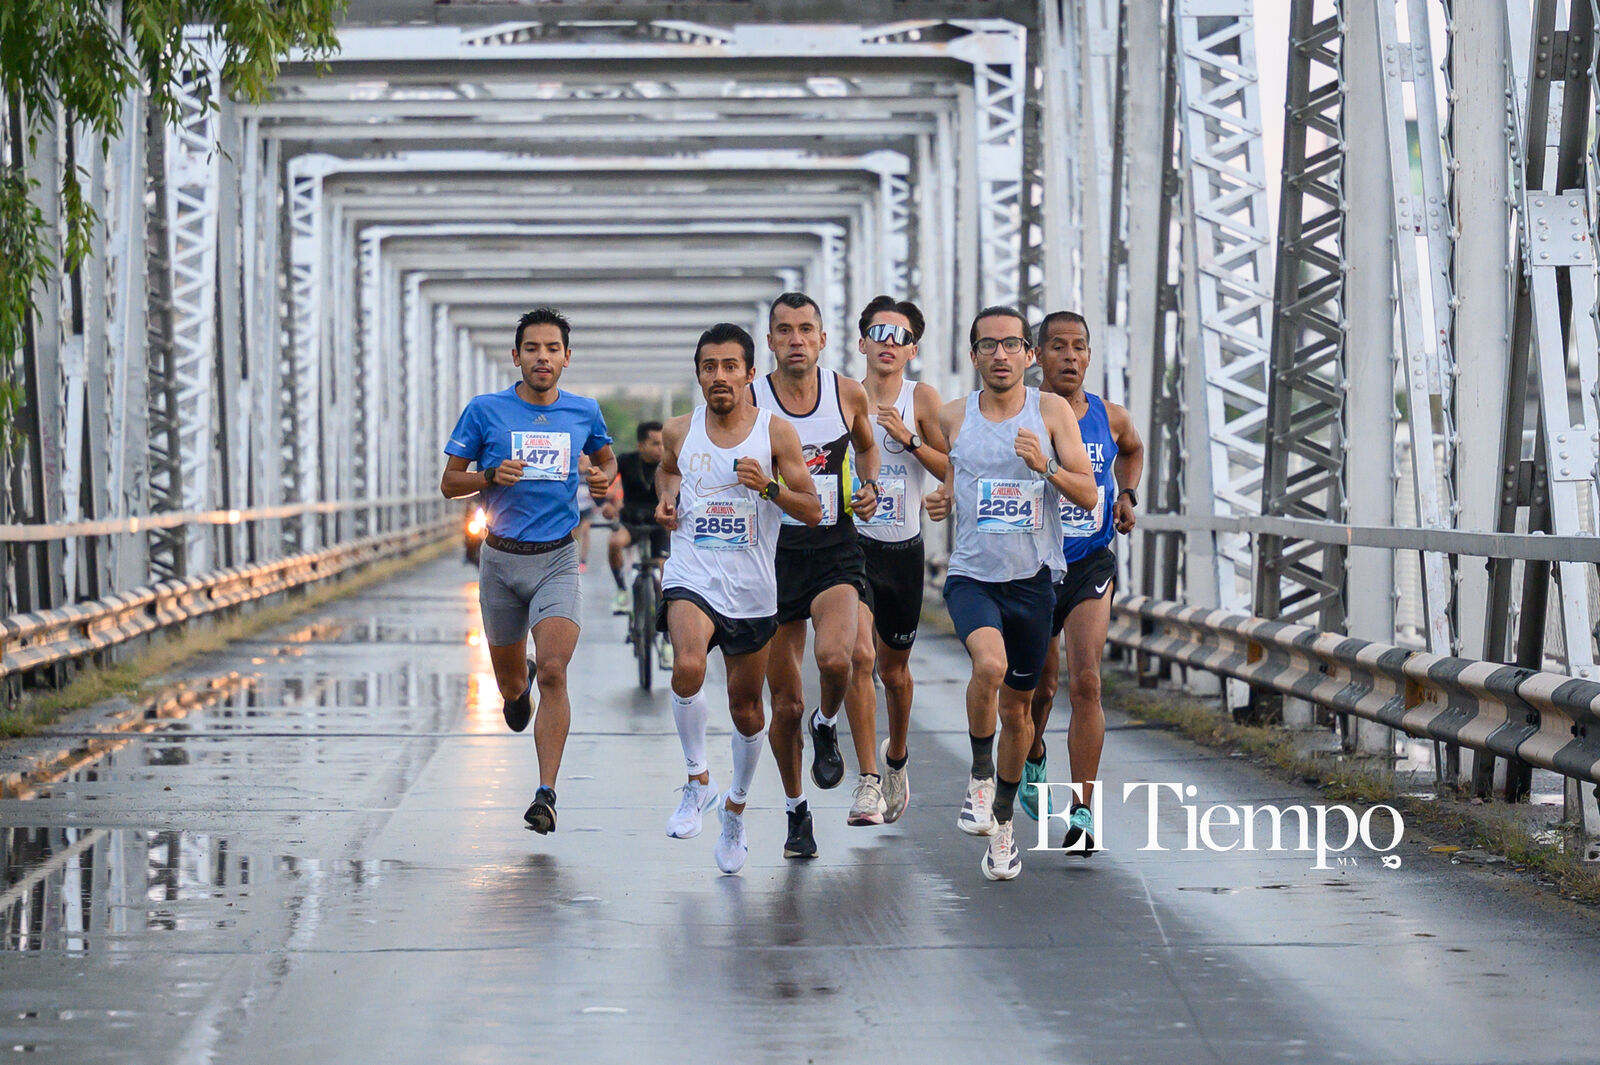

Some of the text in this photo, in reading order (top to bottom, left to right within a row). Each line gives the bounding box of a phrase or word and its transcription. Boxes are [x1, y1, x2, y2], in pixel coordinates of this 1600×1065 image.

[516, 449, 560, 464] 1477
[1082, 442, 1105, 462] EK
[689, 453, 712, 472] CR
[880, 464, 908, 475] ENA
[979, 499, 1032, 517] 2264
[1058, 505, 1095, 521] 291
[695, 518, 746, 534] 2855
